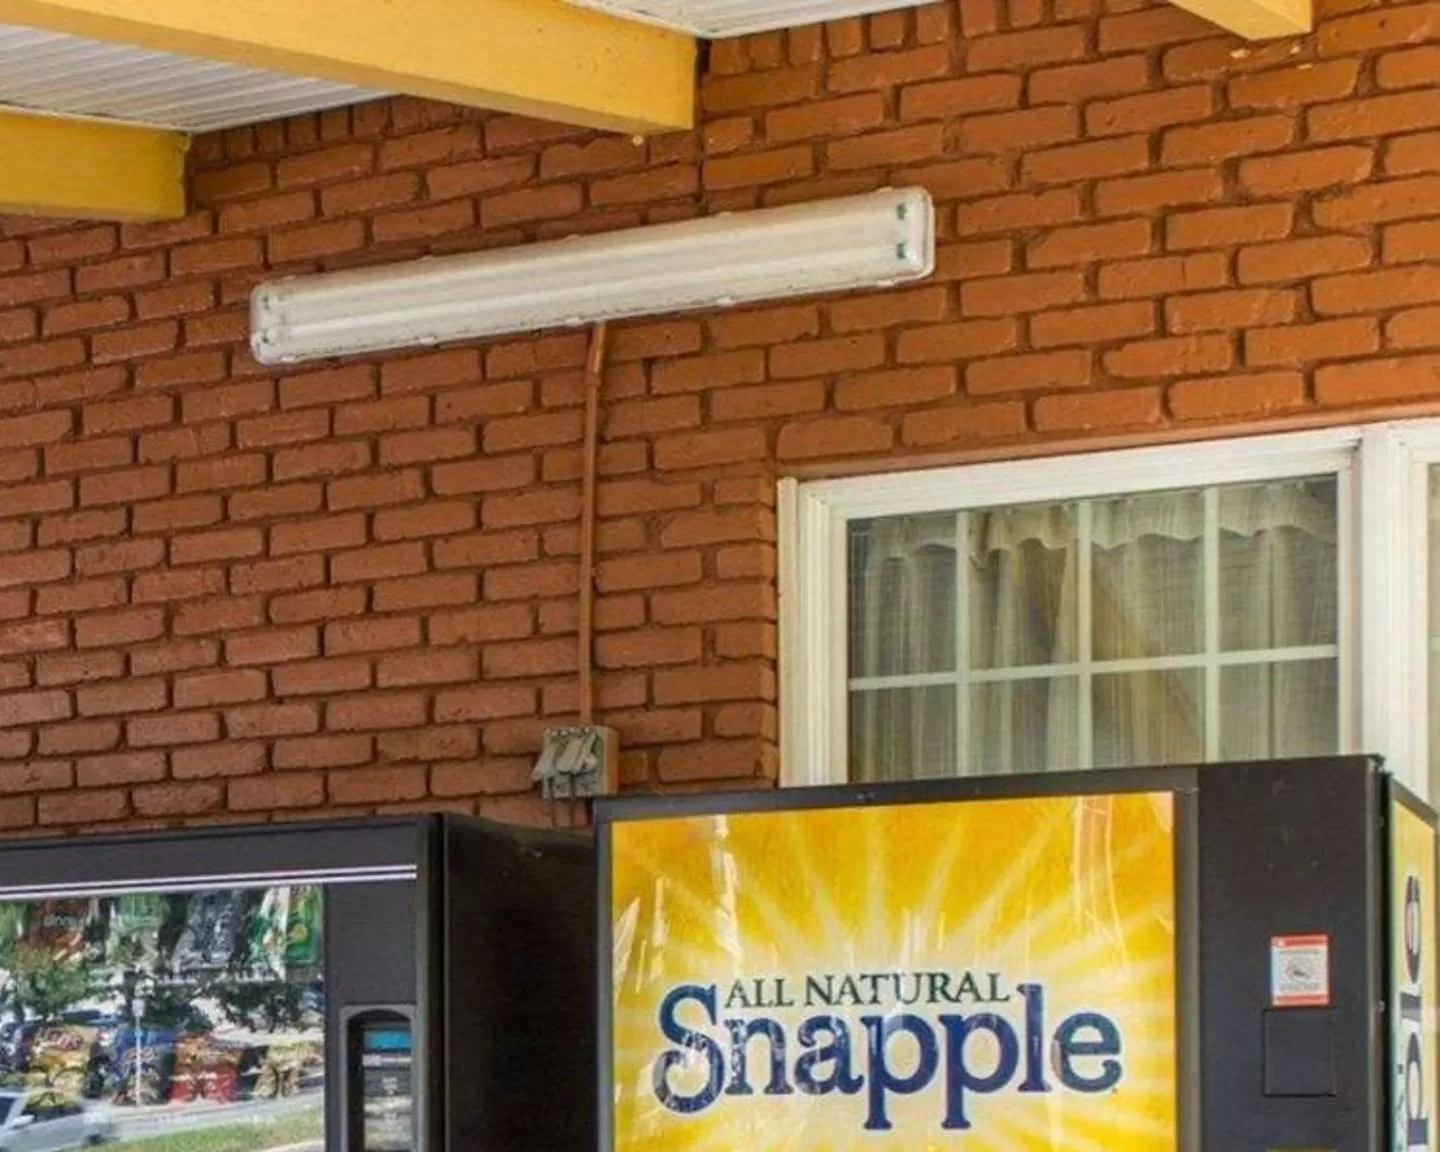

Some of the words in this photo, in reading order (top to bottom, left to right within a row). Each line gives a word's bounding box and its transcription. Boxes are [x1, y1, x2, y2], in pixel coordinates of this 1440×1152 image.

[725, 977, 795, 1009] ALL
[805, 970, 1010, 1006] NATURAL
[653, 982, 1123, 1131] Snapple
